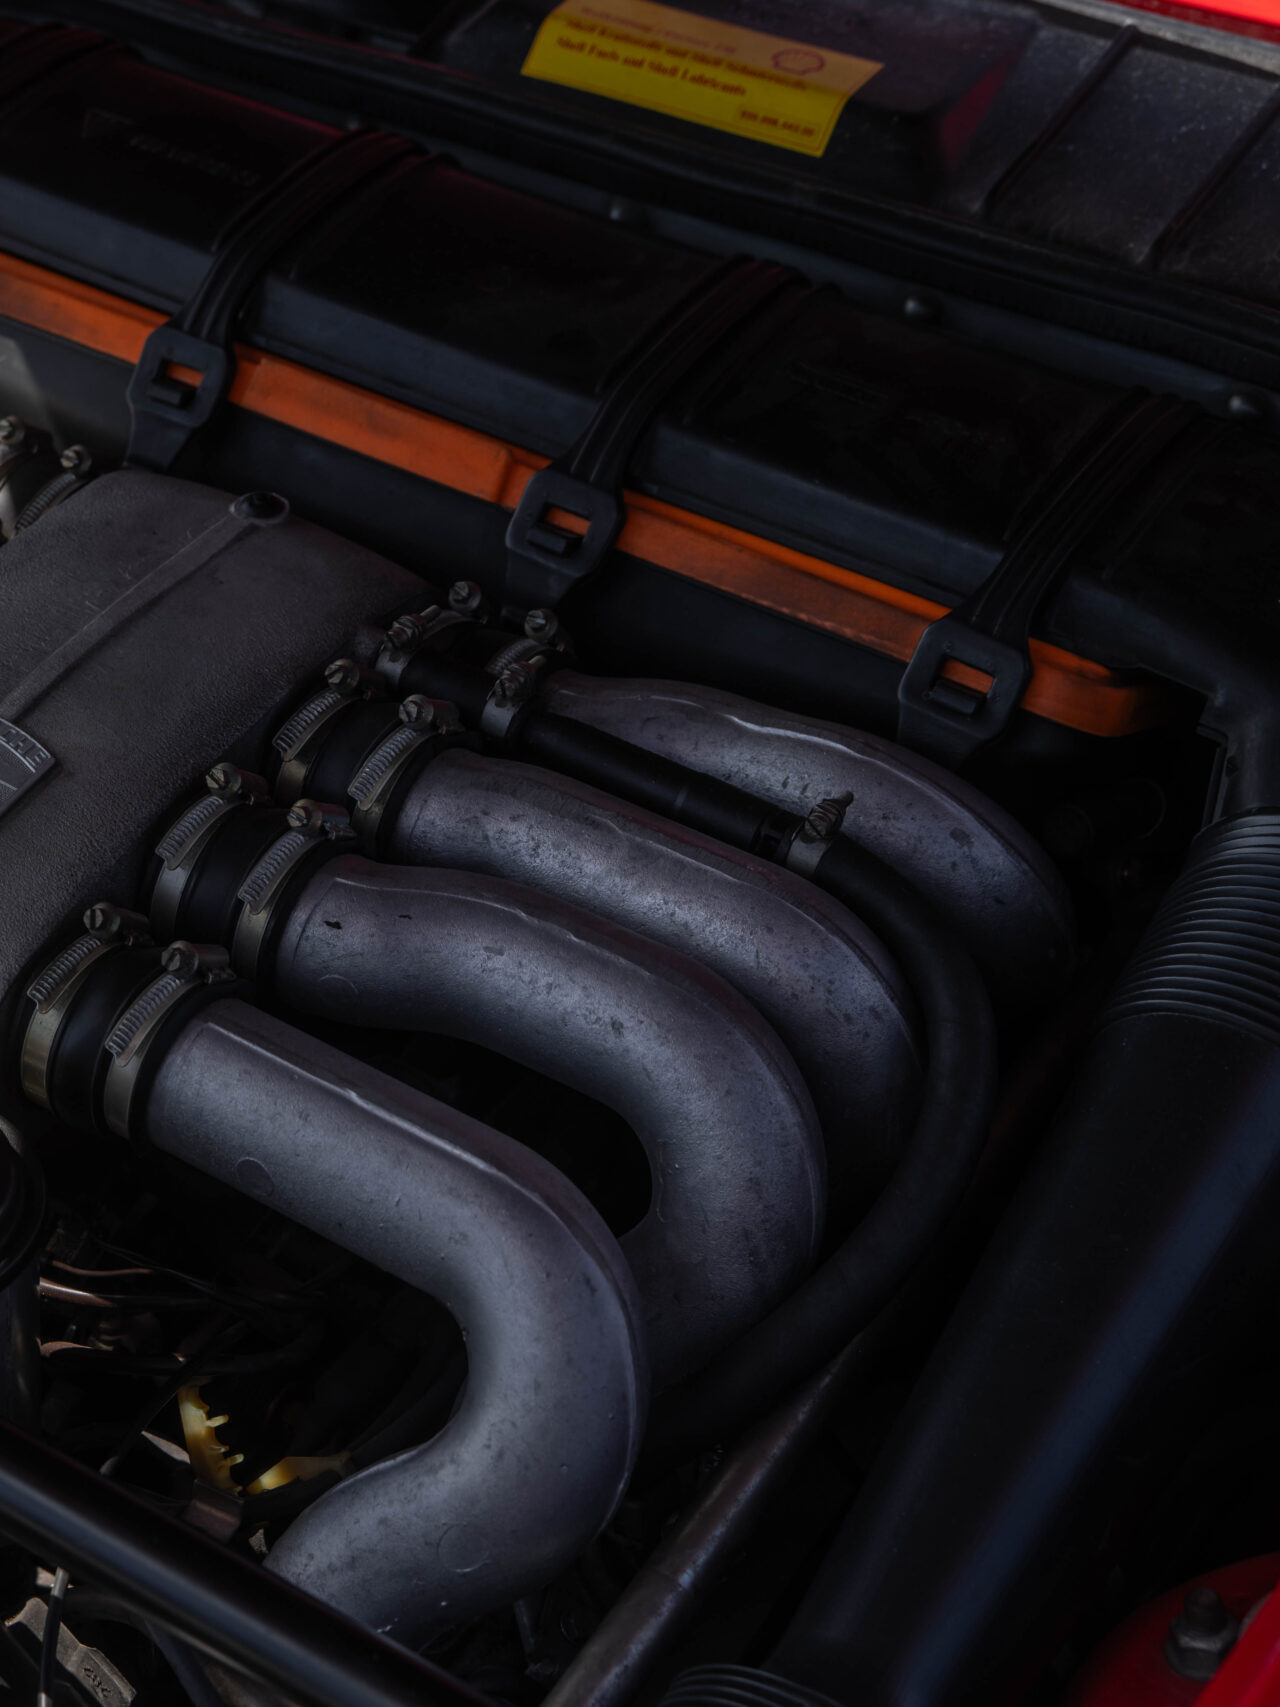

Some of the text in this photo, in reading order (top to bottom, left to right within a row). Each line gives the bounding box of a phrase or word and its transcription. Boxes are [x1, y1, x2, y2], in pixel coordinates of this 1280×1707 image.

[556, 36, 747, 96] Shell Fuels and Shell Lubricants
